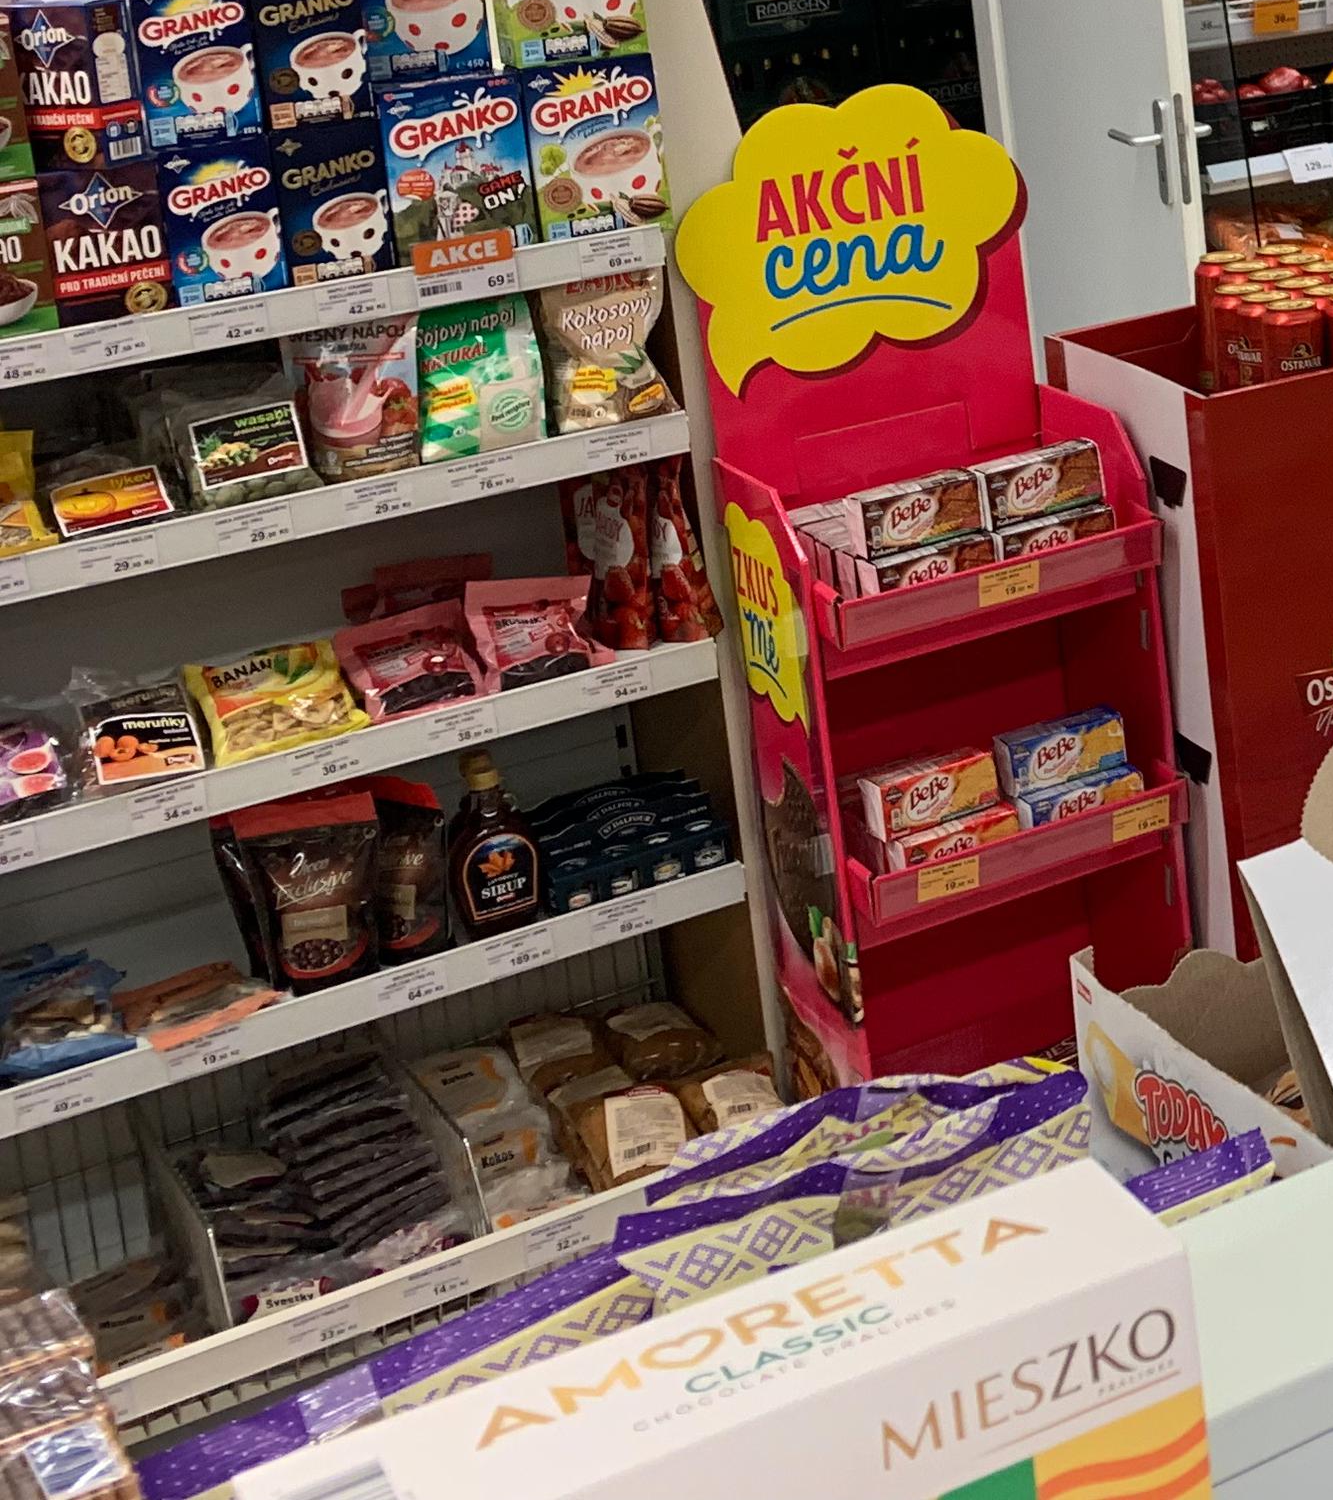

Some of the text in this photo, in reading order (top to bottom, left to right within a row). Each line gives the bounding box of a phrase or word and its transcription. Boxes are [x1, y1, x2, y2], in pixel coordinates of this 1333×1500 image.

[21, 24, 67, 49] Orion
[142, 4, 240, 41] GRANKO
[535, 79, 649, 127] GRANKO
[394, 100, 514, 151] GRANKO
[282, 150, 375, 189] GRANKO
[70, 185, 133, 216] Orion
[172, 169, 268, 210] GRANKO
[483, 184, 525, 210] ON!
[756, 137, 926, 243] AKČNÍ
[53, 225, 162, 273] KAKAO
[430, 239, 498, 267] AKCE
[764, 223, 944, 299] cena
[59, 266, 165, 294] PRO TRADIČNÍ PEČENÍ
[417, 305, 515, 348] Sójový nápoj
[561, 296, 652, 332] Kokosový
[582, 321, 634, 349] nápoj
[421, 342, 488, 374] NATURAL
[1014, 466, 1053, 497] BeBe
[891, 496, 932, 528] BeBe
[733, 546, 779, 617] ZKUS
[122, 714, 186, 735] meruňky
[1036, 735, 1076, 769] BeBe
[910, 775, 949, 811] BeBe
[481, 877, 527, 900] SIRUP
[481, 1149, 515, 1169] Kokos
[632, 1299, 957, 1433] CHOCOLATE PRALINES
[684, 1304, 893, 1395] CLASSIC
[880, 1308, 1178, 1470] MIESZKO
